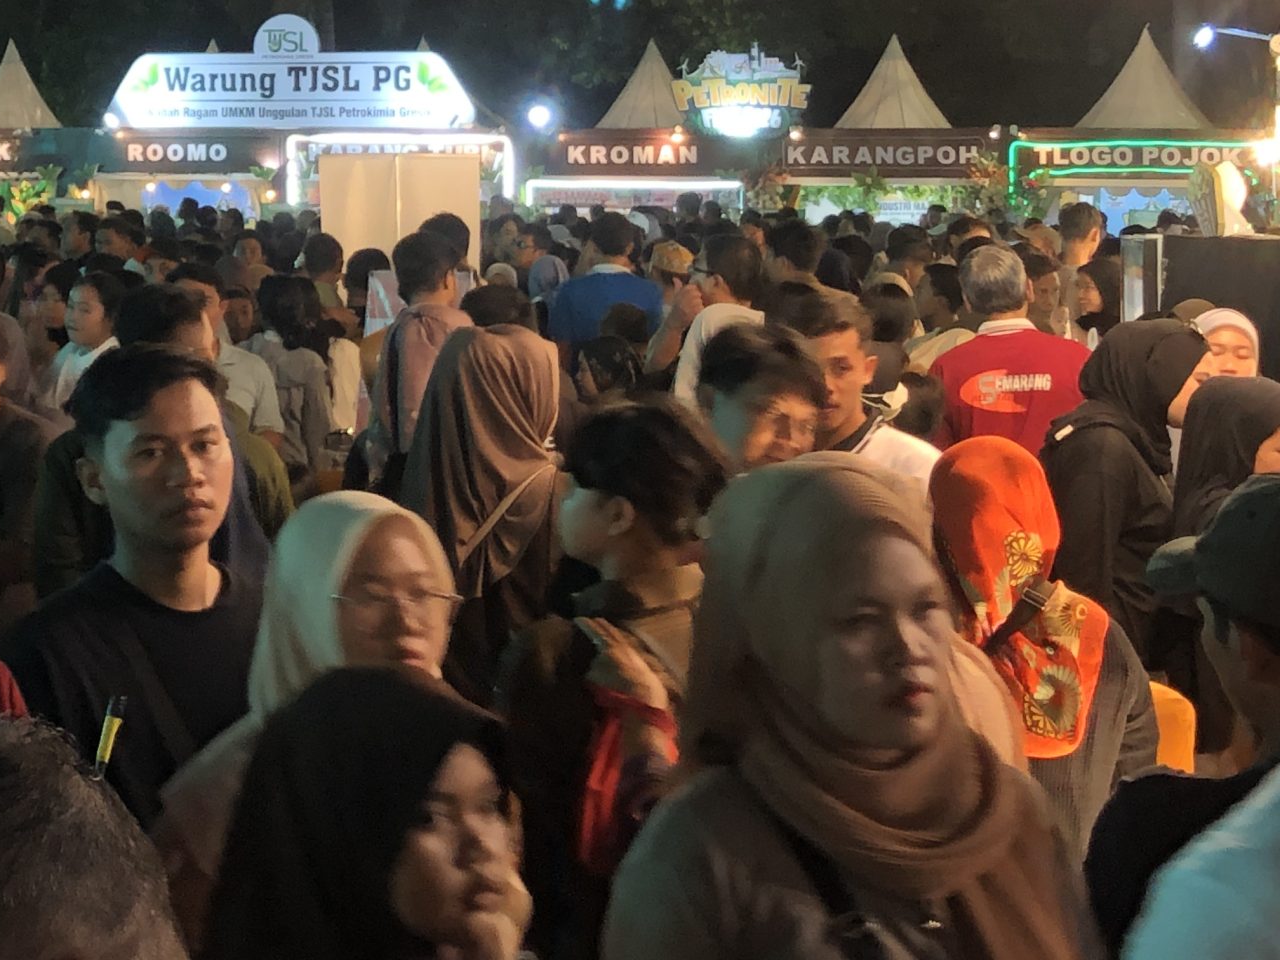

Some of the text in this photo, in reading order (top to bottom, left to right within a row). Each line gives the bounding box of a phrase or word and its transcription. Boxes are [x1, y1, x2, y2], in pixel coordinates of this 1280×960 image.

[164, 66, 411, 98] Warung TJSL PG
[183, 106, 217, 120] Ragam
[221, 106, 255, 118] UMKM
[258, 106, 307, 120] Unggulan
[310, 106, 335, 118] TJSL
[338, 106, 395, 118] Petrokimia
[127, 143, 227, 162] ROOMO
[567, 145, 698, 164] KROMAN
[787, 145, 978, 165] KARANGPOH
[1033, 146, 1244, 167] TLOGO POJOK
[978, 374, 1051, 404] SEMARANG
